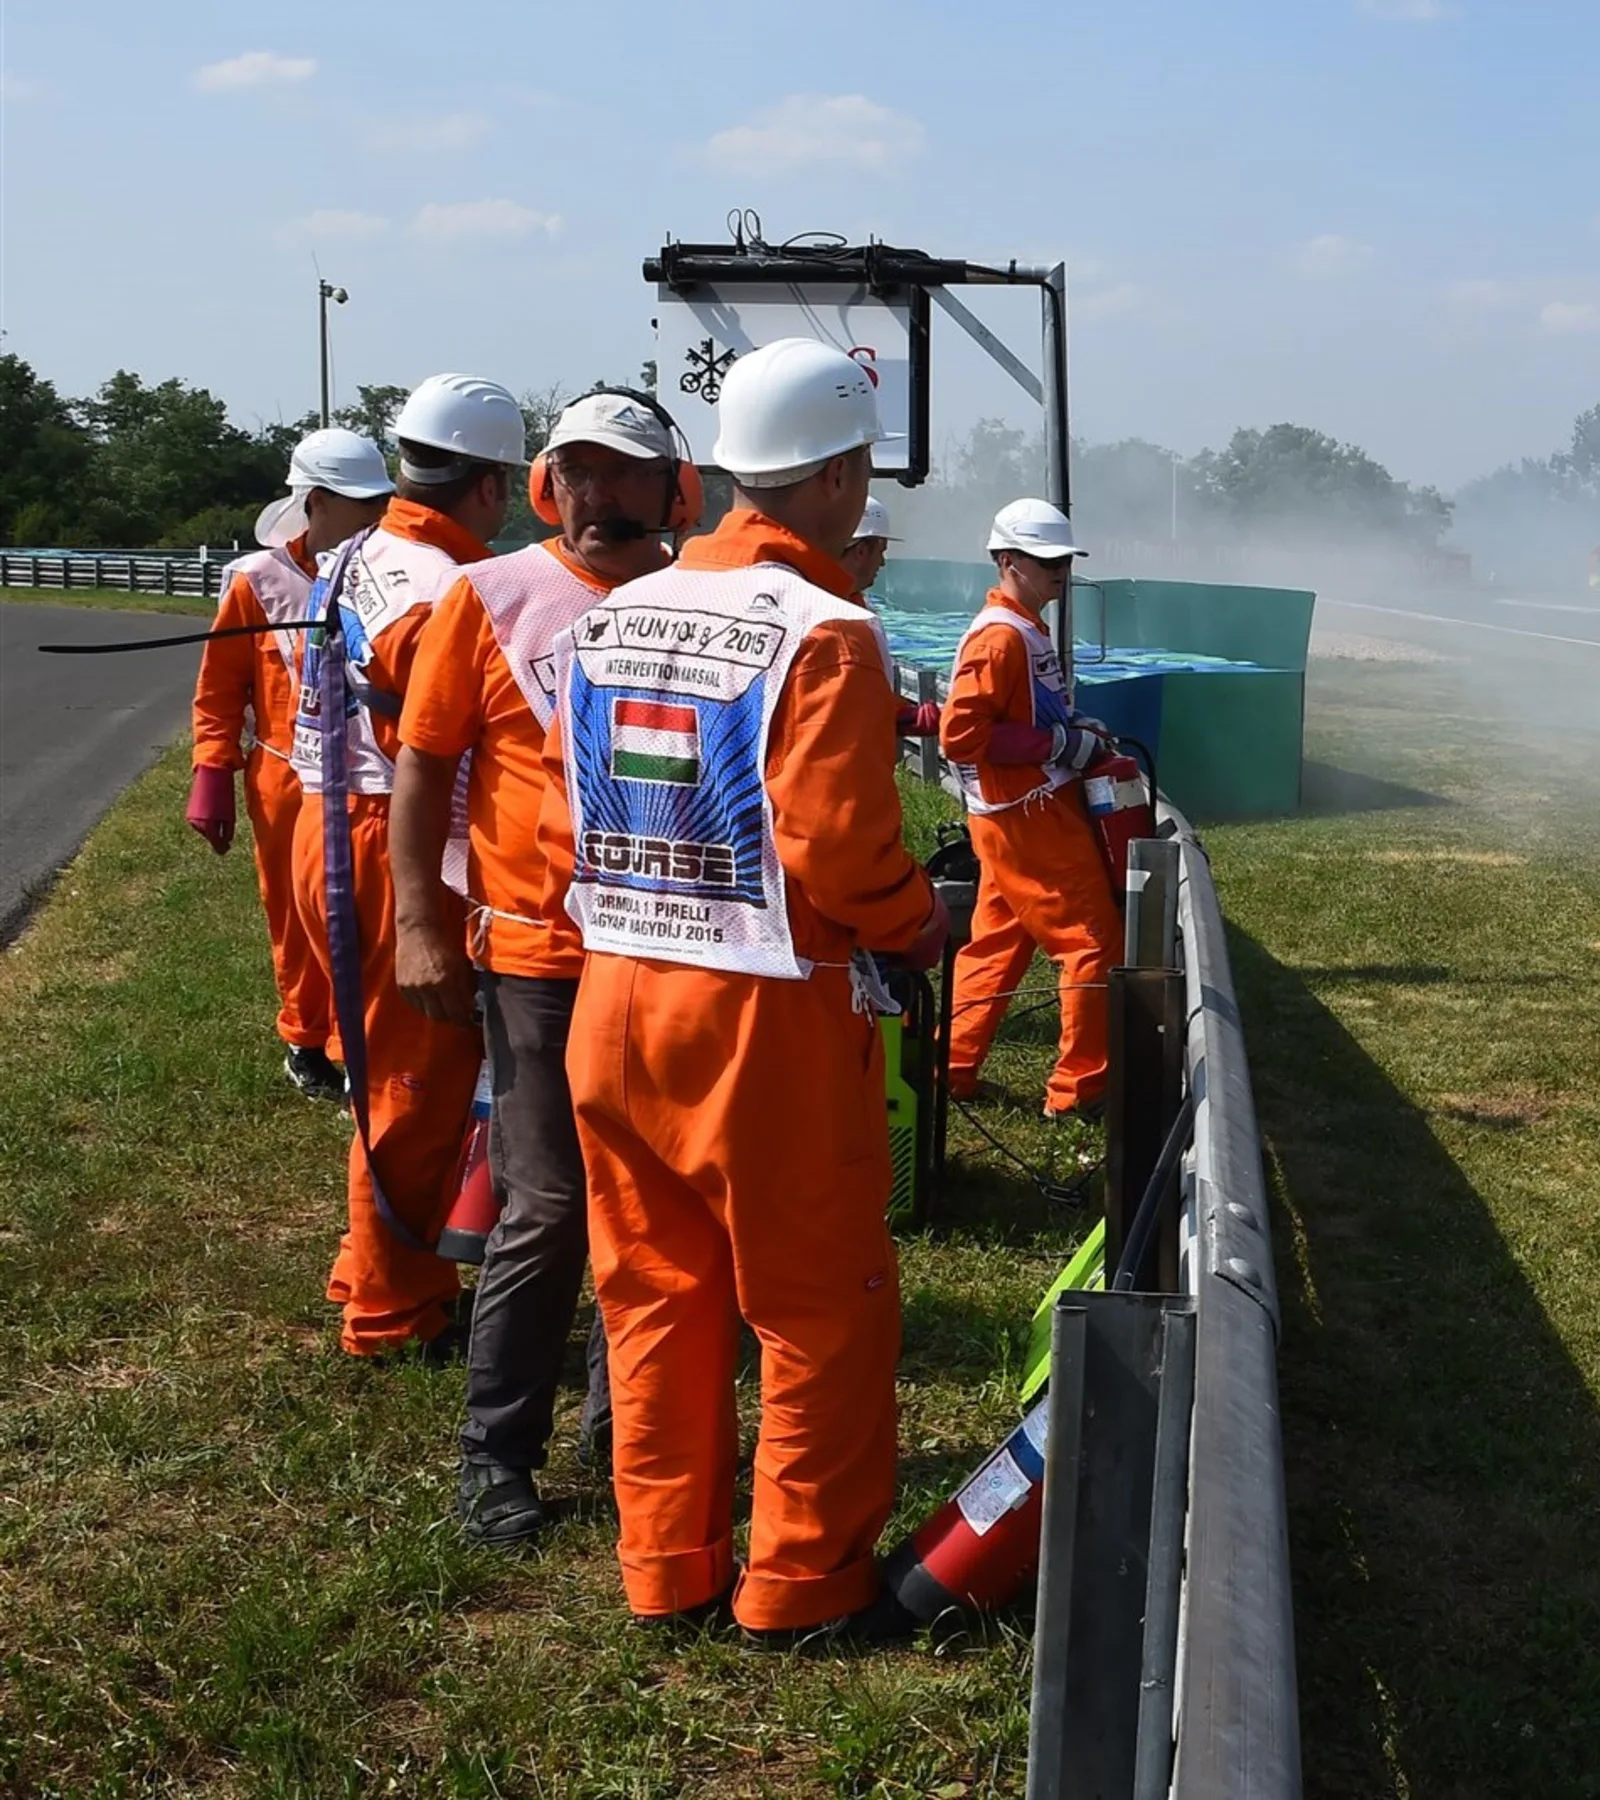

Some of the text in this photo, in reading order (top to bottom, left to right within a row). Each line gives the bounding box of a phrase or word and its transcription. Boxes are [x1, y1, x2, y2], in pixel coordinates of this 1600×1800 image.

[724, 627, 769, 656] 2015
[655, 900, 711, 922] PIRELLI
[686, 925, 724, 944] 2015
